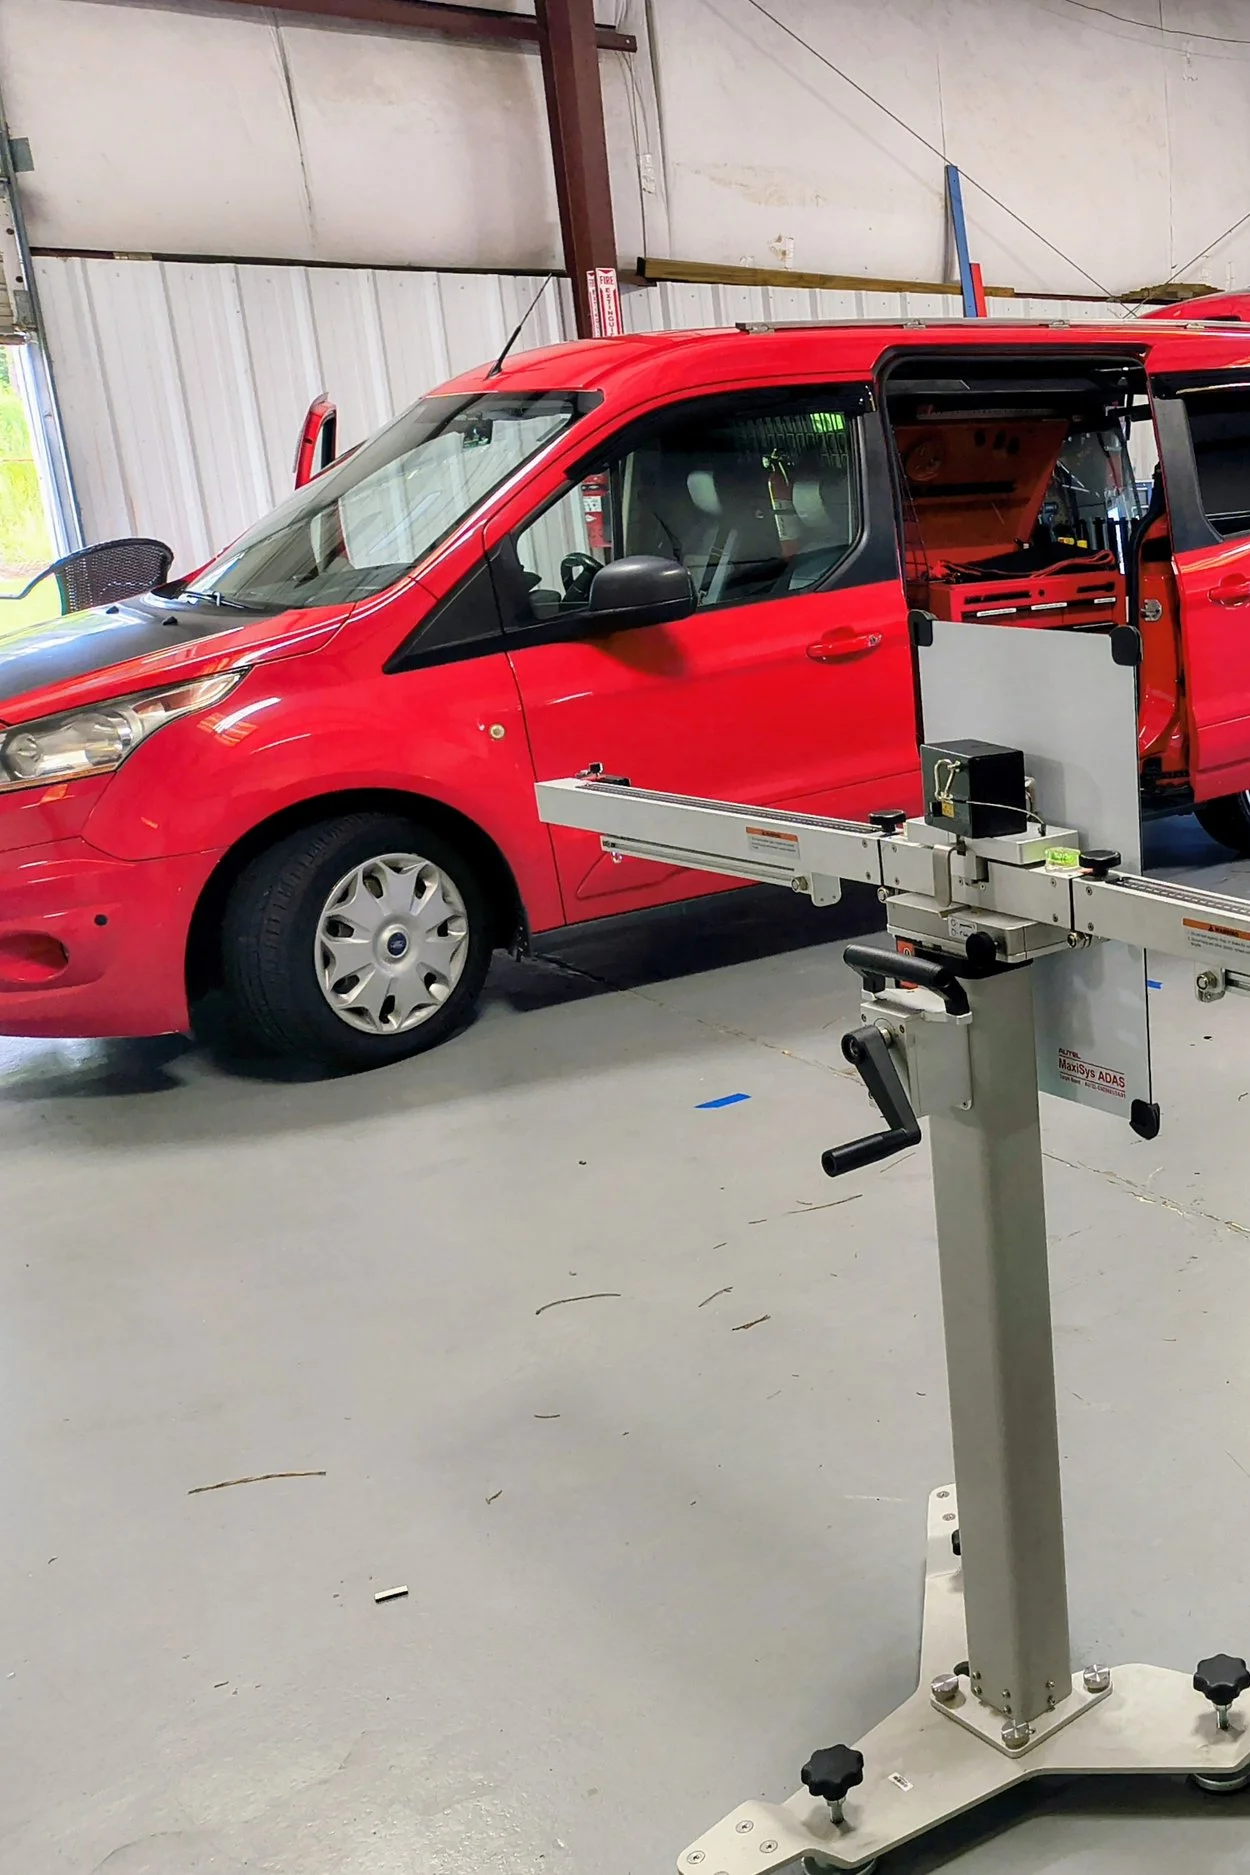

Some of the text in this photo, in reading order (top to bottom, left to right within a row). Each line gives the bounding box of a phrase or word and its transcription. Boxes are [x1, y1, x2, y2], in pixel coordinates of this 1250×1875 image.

[600, 276, 614, 285] FIRE
[1058, 1048, 1081, 1059] AUTEL
[1058, 1058, 1096, 1079] MaxiSys
[1098, 1071, 1126, 1088] ADAS
